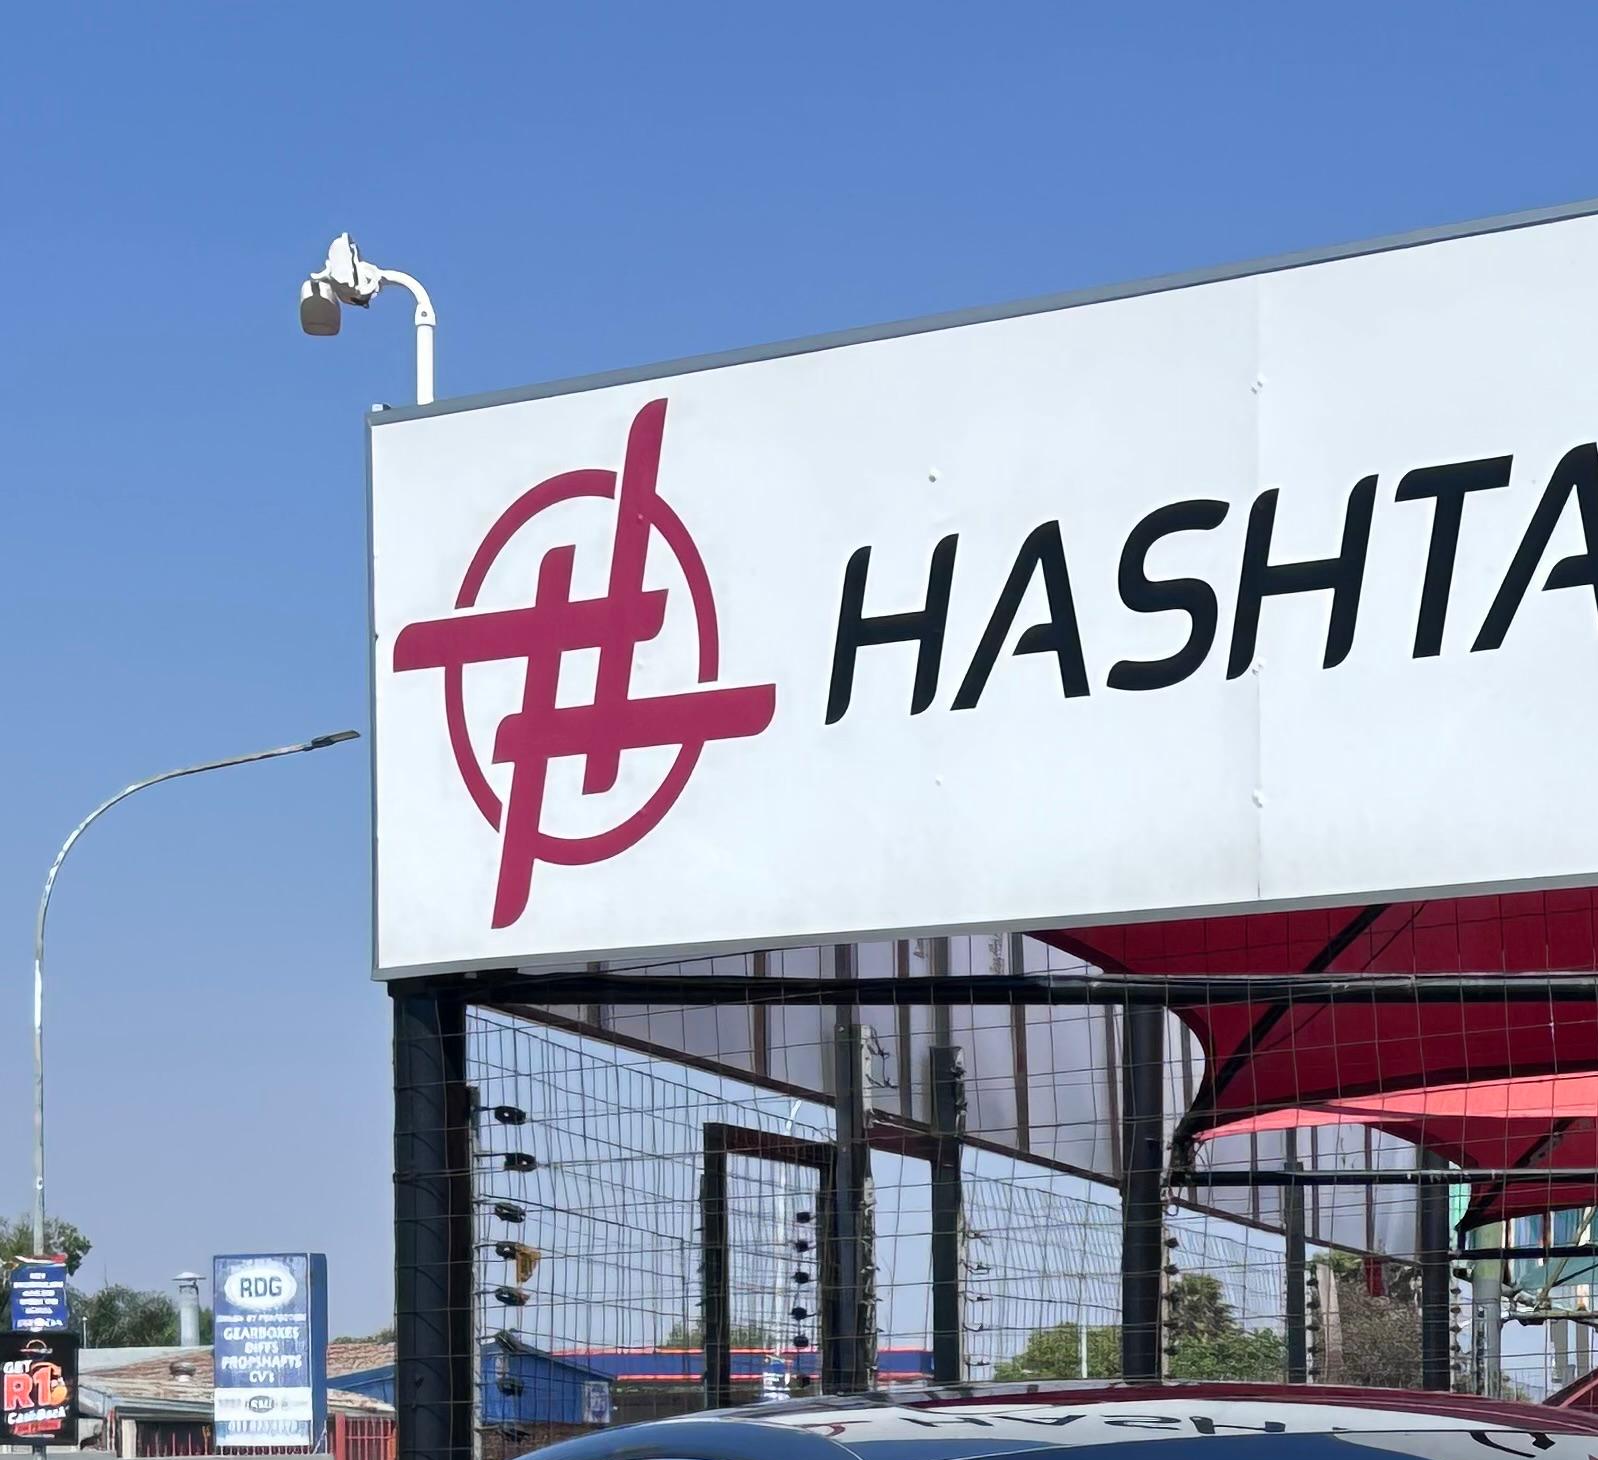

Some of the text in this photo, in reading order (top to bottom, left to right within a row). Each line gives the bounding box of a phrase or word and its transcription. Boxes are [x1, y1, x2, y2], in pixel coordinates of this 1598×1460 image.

[240, 1276, 282, 1298] RDG
[224, 1327, 300, 1340] GEARBOXES
[221, 1355, 303, 1370] PROPSHAFTS
